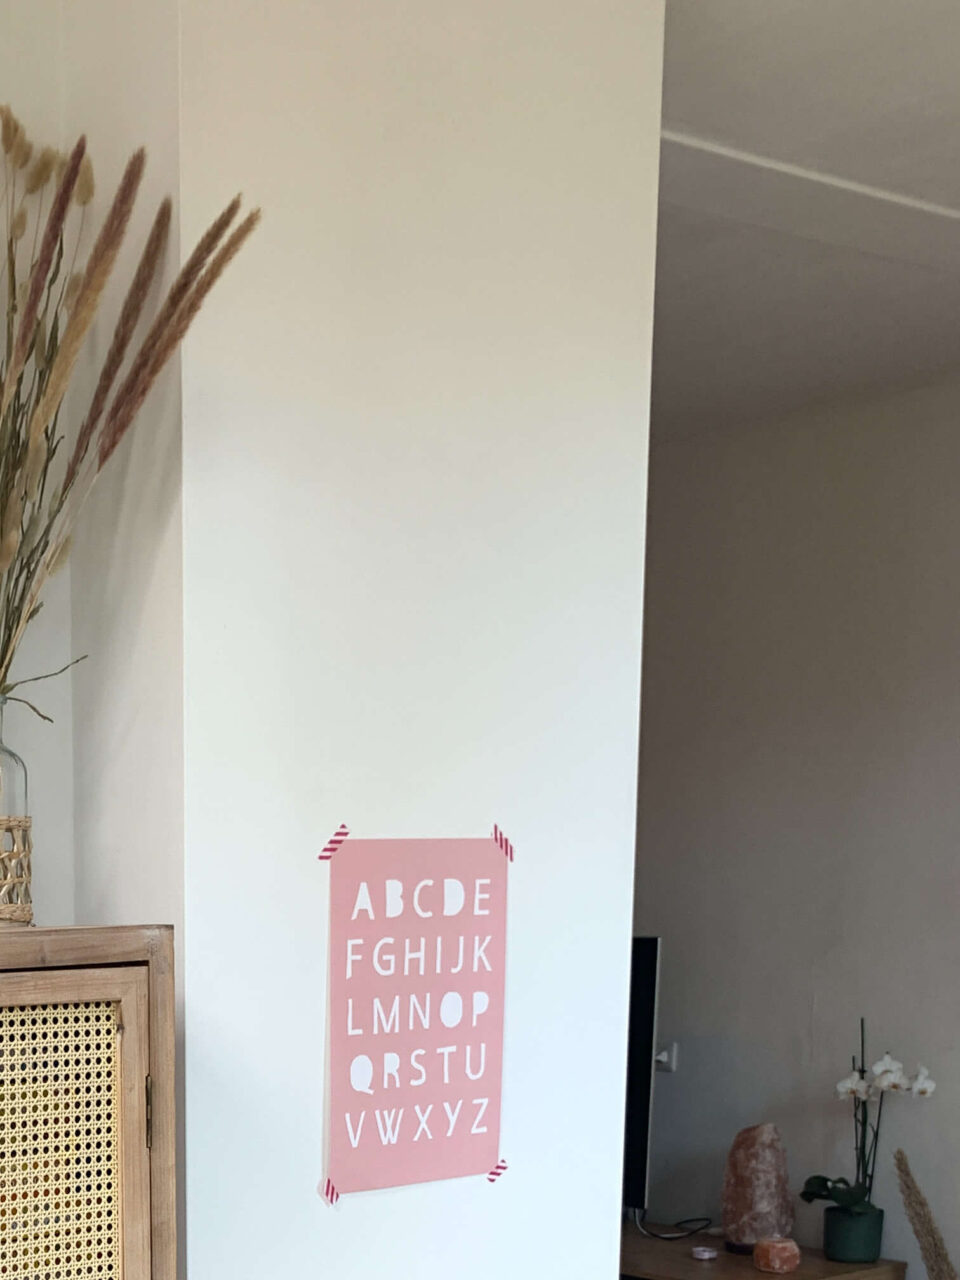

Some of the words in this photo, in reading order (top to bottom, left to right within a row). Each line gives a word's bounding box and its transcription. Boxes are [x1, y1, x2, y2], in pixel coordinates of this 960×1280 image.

[351, 878, 492, 920] ABCDE
[345, 935, 493, 979] FGHIJK
[347, 991, 490, 1036] LMNOP
[350, 1043, 487, 1095] QRSTU
[344, 1097, 490, 1149] VWXYZ
